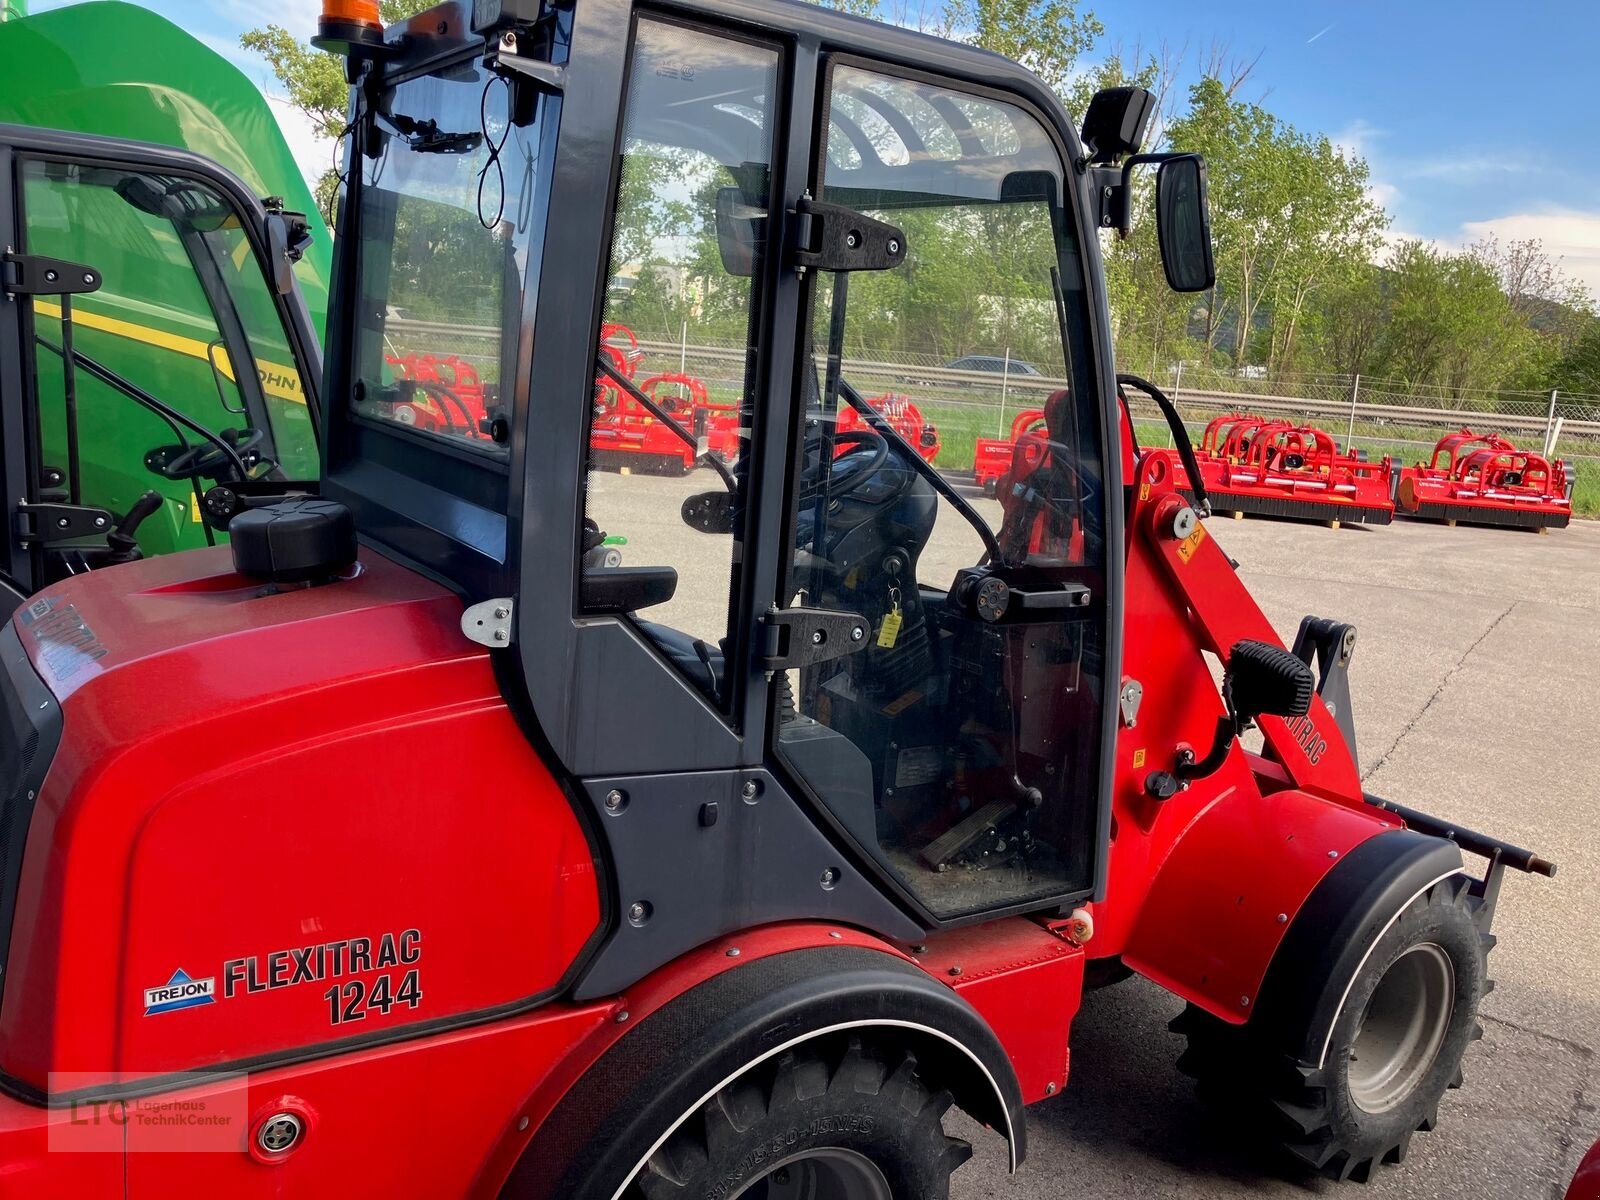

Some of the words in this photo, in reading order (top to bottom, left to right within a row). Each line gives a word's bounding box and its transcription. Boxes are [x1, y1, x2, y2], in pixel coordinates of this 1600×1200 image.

[259, 369, 296, 390] OHN
[223, 928, 421, 998] FLEXITRAC
[149, 980, 208, 1003] TREJON
[324, 969, 422, 1026] 1244
